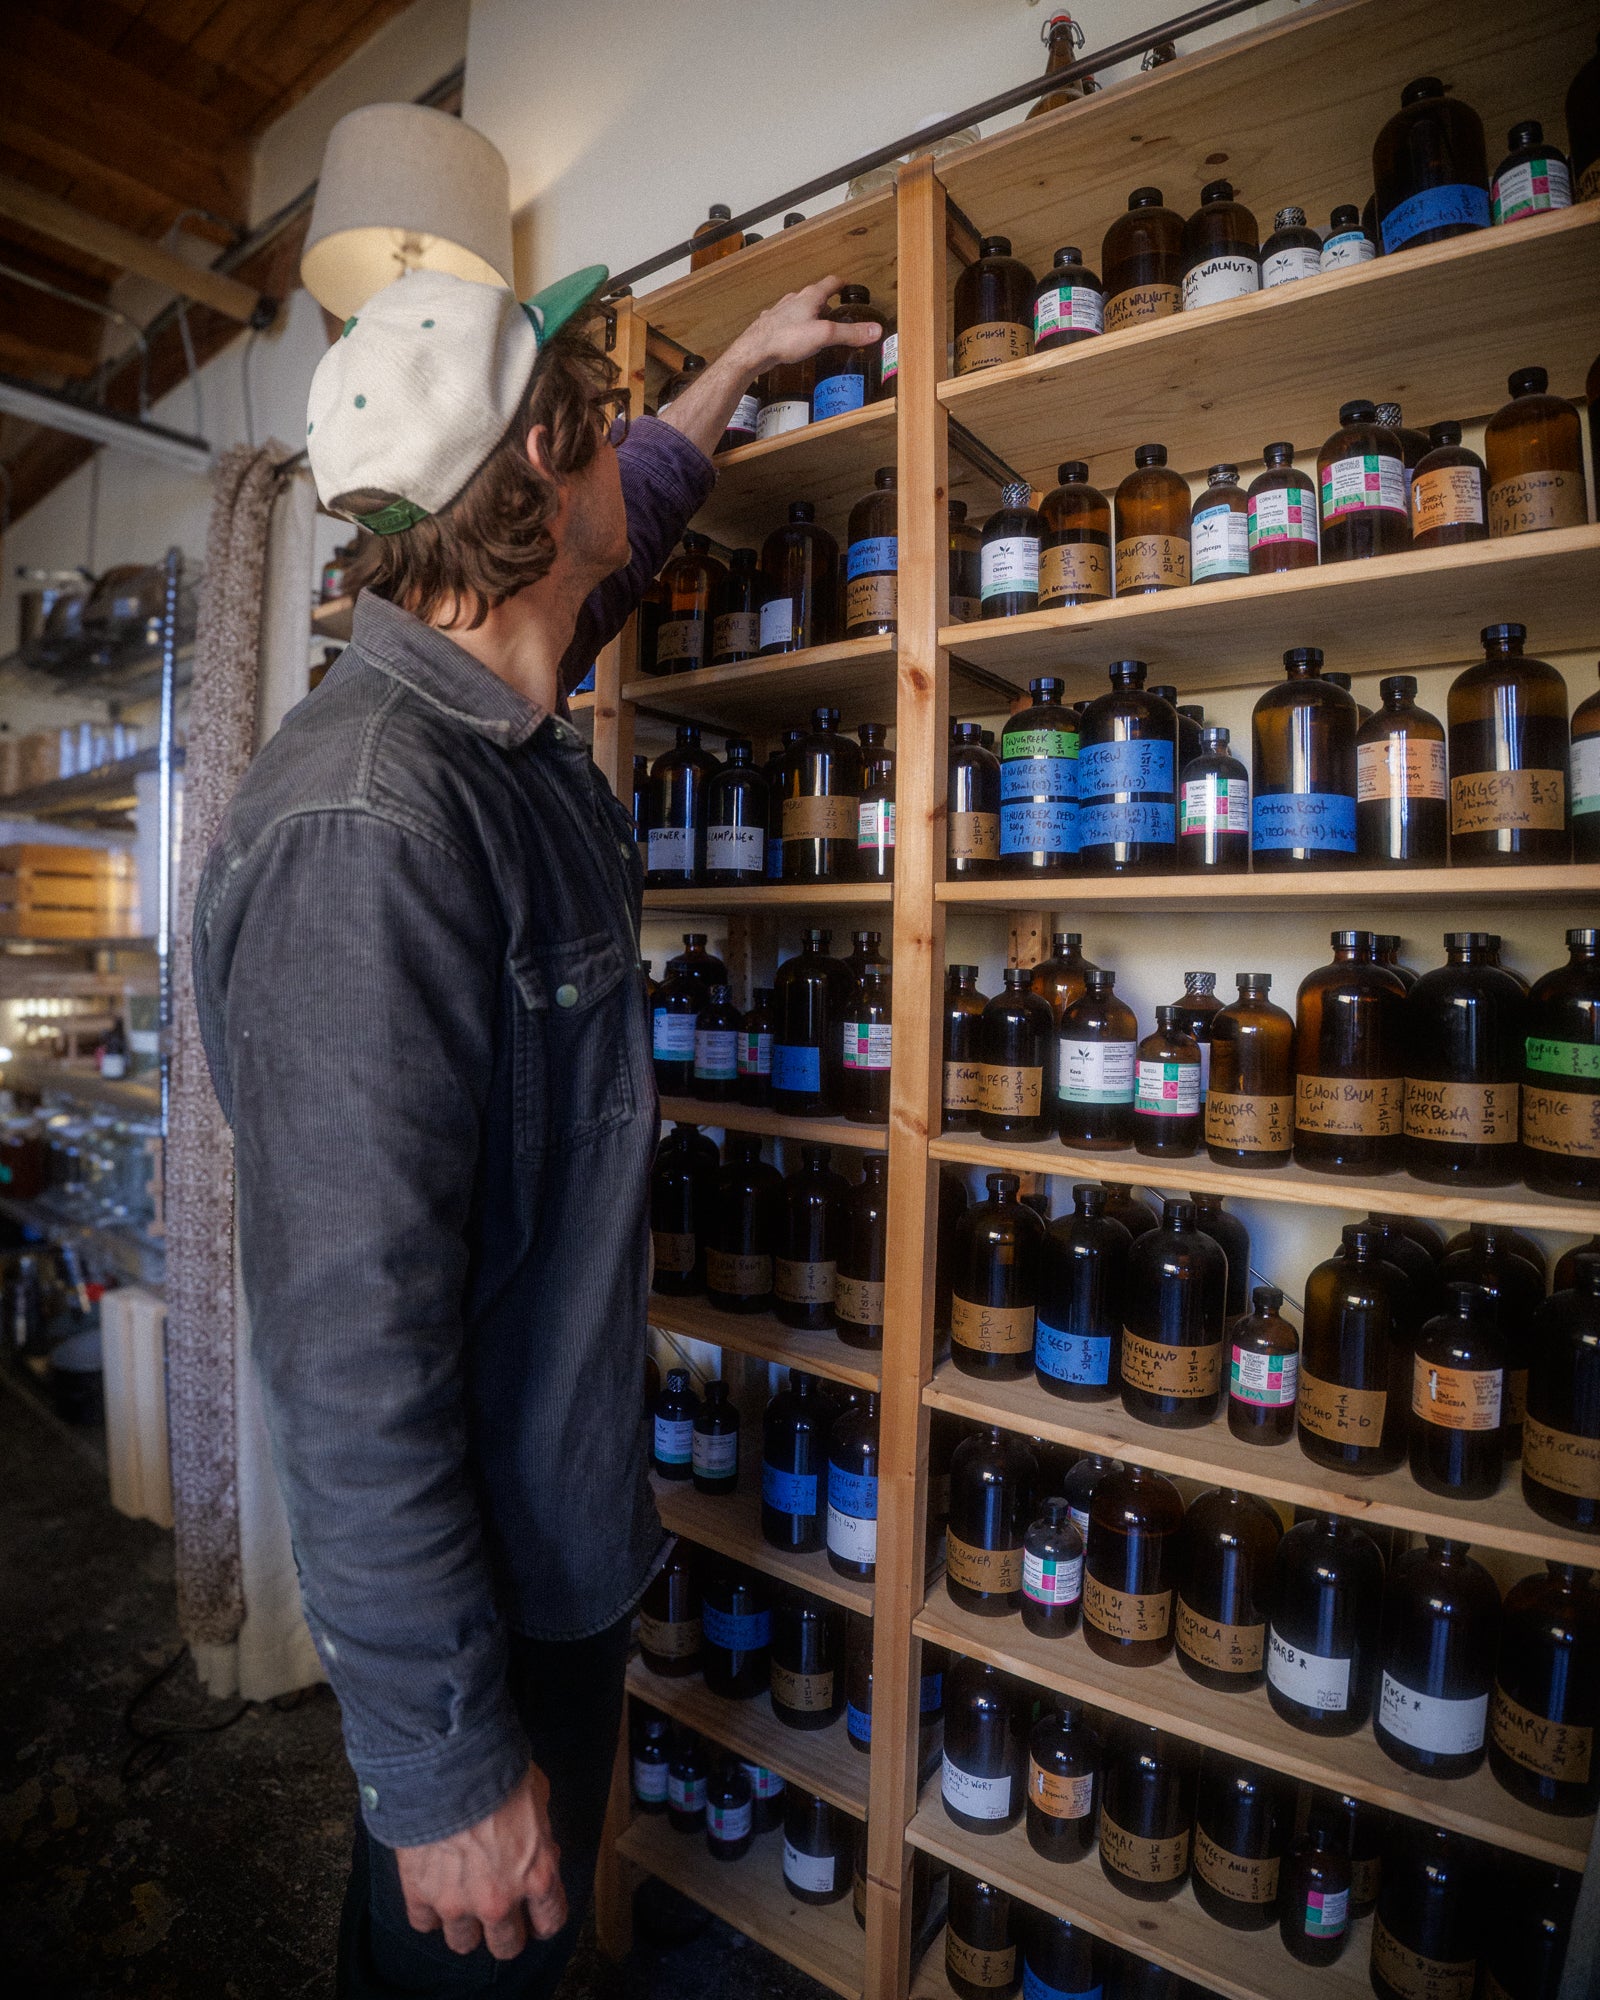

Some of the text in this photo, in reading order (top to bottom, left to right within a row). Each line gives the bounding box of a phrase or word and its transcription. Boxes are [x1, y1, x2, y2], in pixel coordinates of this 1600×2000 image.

[1201, 261, 1245, 277] WALNUT
[1130, 291, 1170, 306] WALNUT
[1195, 544, 1222, 556] Cordyceps
[993, 565, 1013, 573] Cleavers
[1455, 775, 1514, 802] GINGER
[1299, 1081, 1339, 1101] LEMON
[1344, 1085, 1374, 1104] BALM
[1048, 1336, 1073, 1352] SEED
[1134, 1342, 1177, 1362] ENGLAND
[960, 1548, 992, 1568] CLOVER
[1384, 1680, 1408, 1705] ROSE
[971, 1781, 992, 1791] WORT
